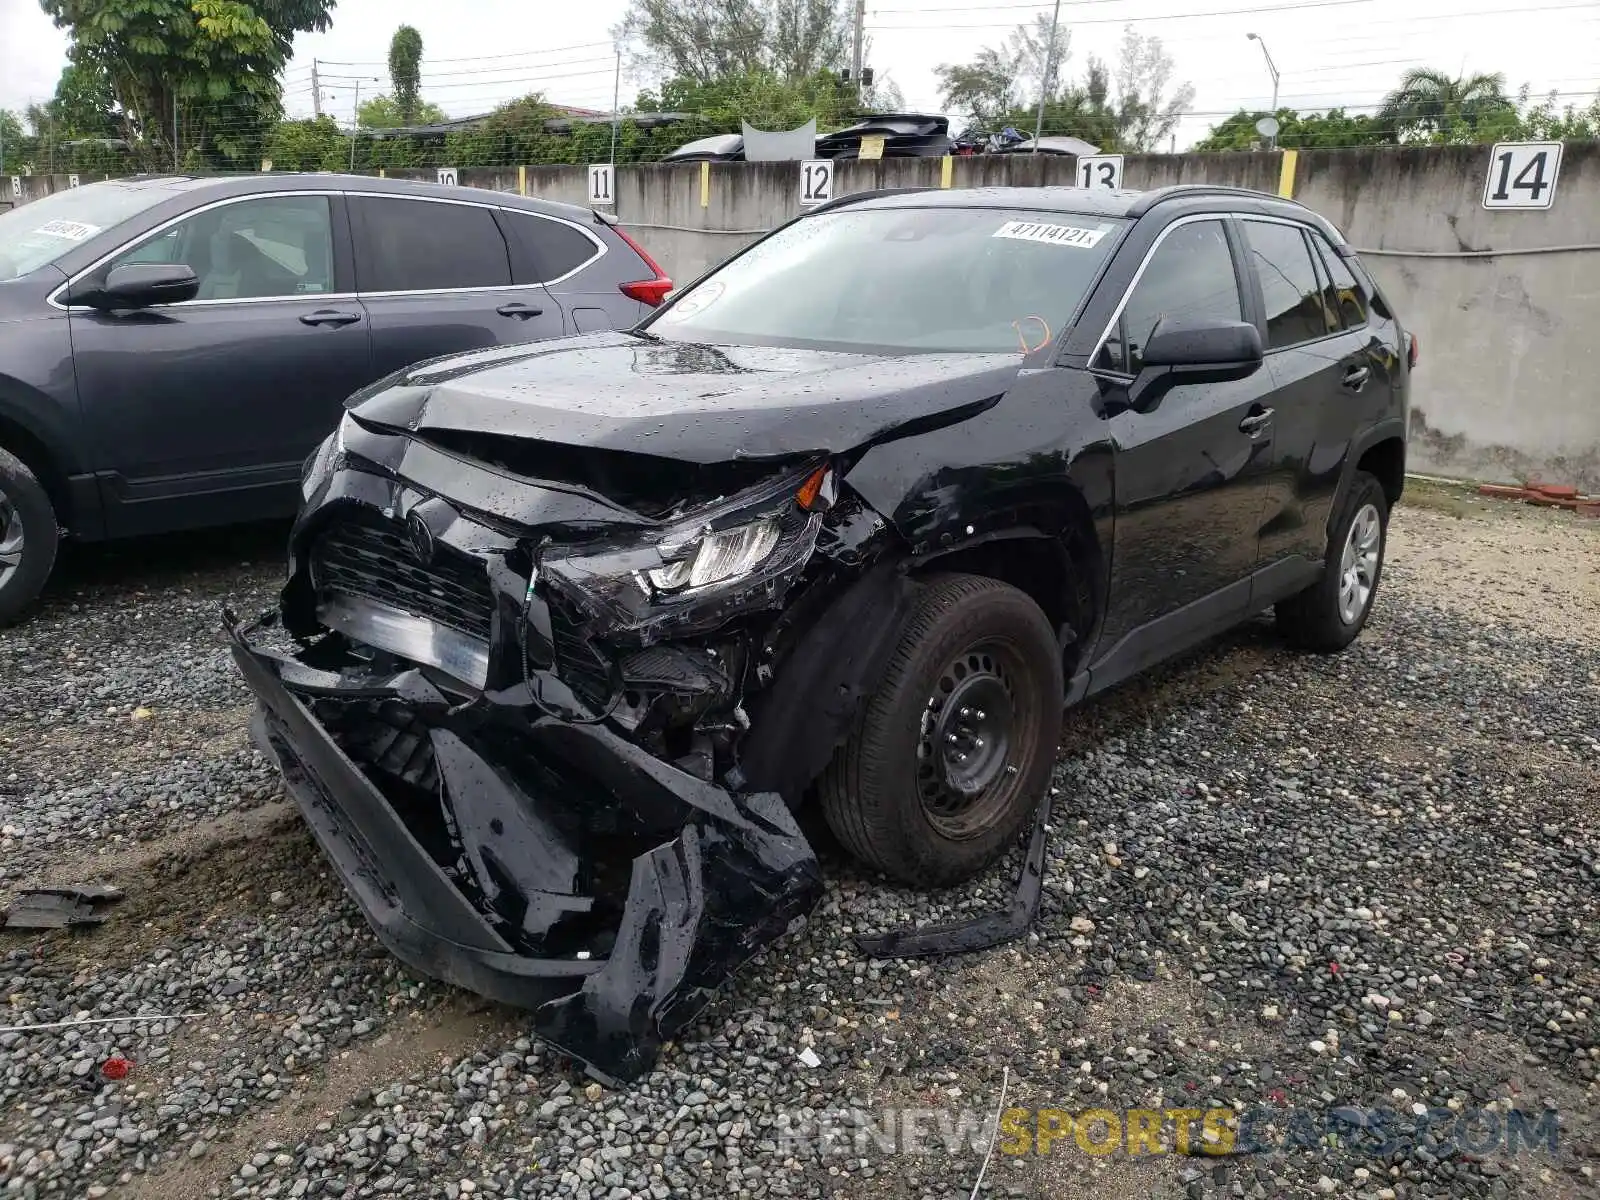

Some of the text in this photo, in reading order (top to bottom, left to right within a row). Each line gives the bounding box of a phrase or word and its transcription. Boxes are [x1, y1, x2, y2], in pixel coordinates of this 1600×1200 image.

[592, 169, 610, 199] 11
[804, 165, 829, 199] 12
[1082, 162, 1116, 188] 13
[1492, 152, 1548, 200] 14
